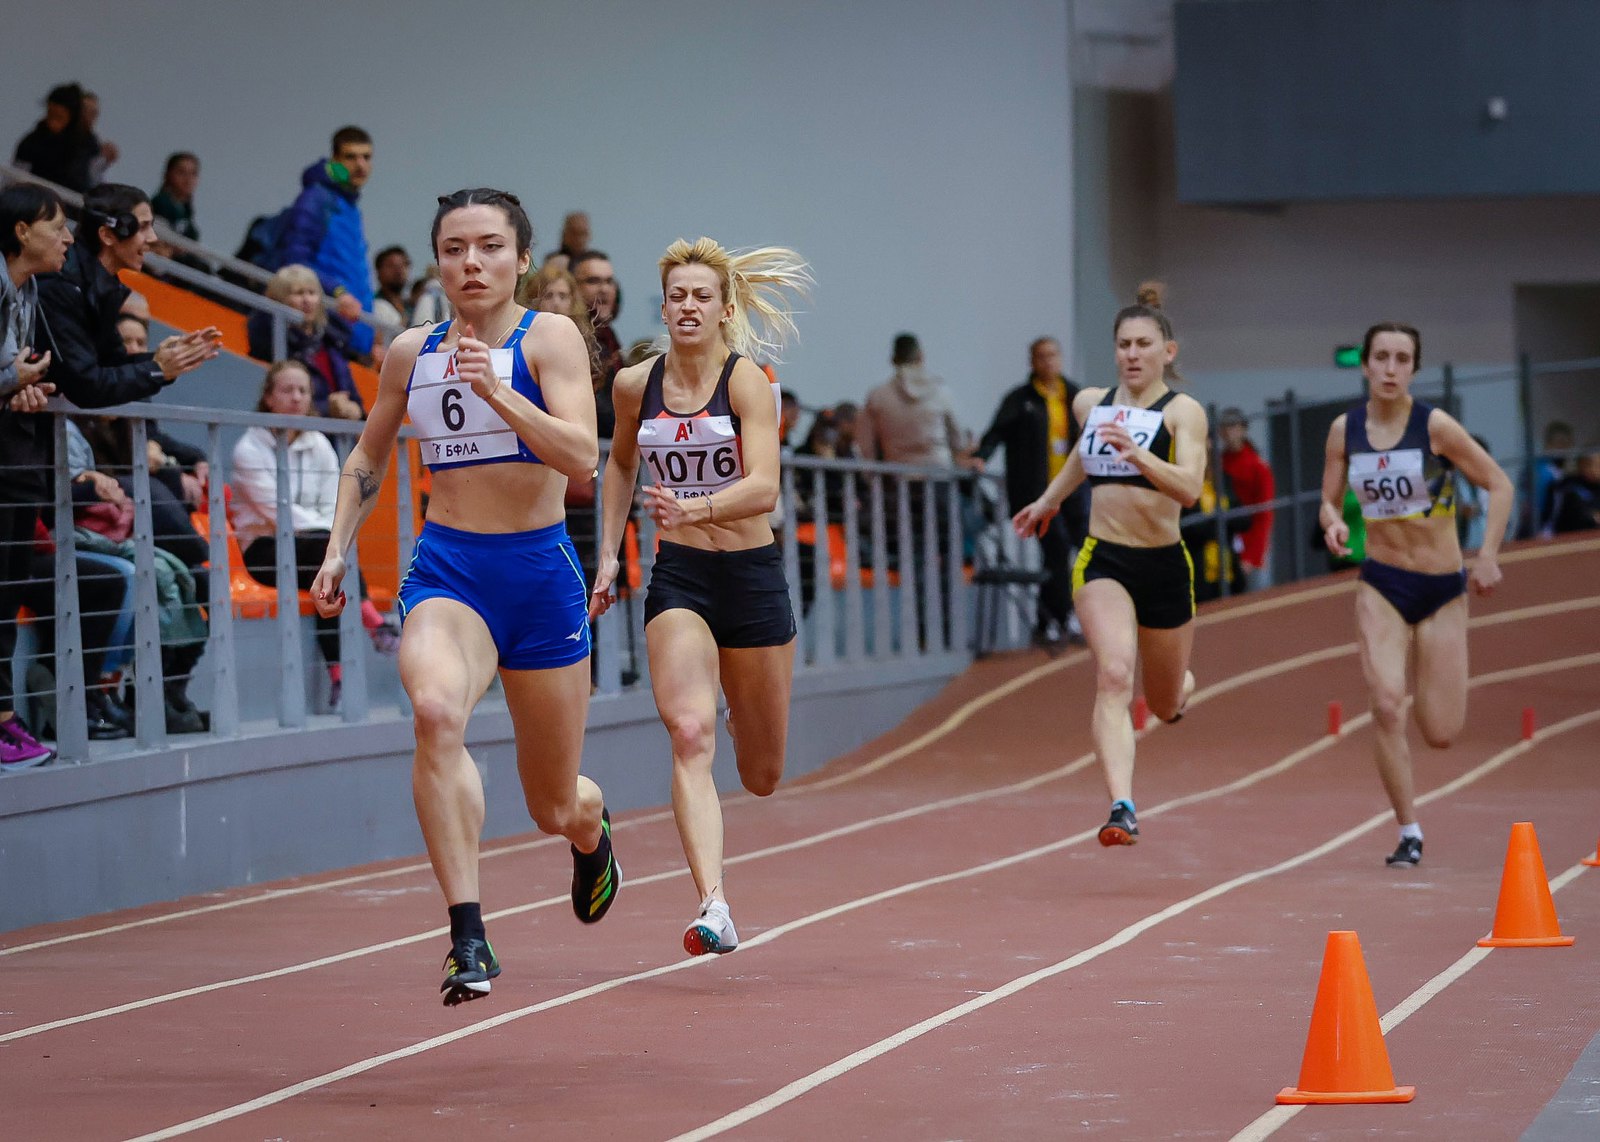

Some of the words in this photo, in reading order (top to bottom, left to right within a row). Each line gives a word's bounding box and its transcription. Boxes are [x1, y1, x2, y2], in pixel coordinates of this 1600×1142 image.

[442, 388, 465, 432] 6
[674, 420, 693, 442] A1
[1086, 430, 1149, 455] 122
[446, 442, 480, 457] БФЛА
[648, 446, 736, 483] 1076
[1363, 476, 1413, 501] 560
